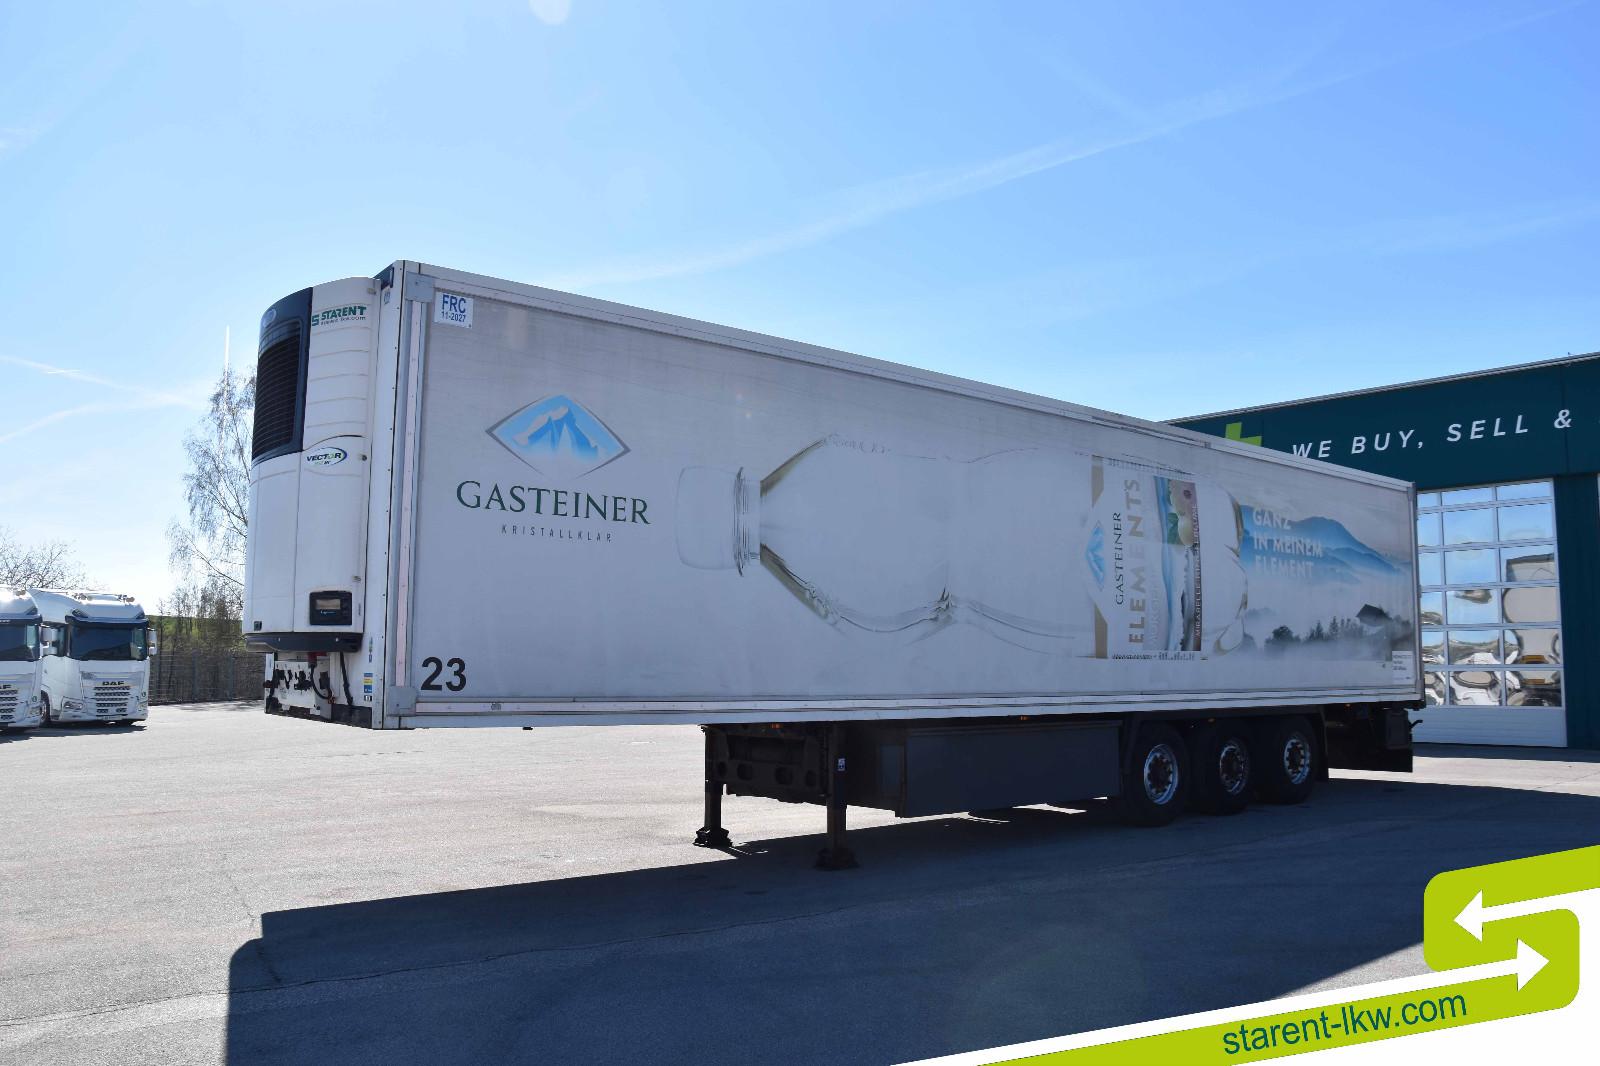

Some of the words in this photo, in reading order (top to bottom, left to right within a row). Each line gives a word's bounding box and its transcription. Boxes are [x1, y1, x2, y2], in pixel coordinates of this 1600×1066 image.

[321, 305, 367, 321] STARENT
[442, 294, 466, 313] FRC
[441, 311, 466, 322] 11-2027
[1293, 440, 1332, 459] WE
[1351, 429, 1425, 455] BUY,
[1446, 413, 1529, 442] SELL
[1553, 409, 1572, 428] &
[306, 452, 342, 462] VECTOR
[456, 480, 651, 525] GASTEINER
[1253, 508, 1292, 530] GANZ
[501, 524, 612, 543] KRISTALLKLAR
[1254, 532, 1268, 550] IN
[1274, 536, 1323, 558] MEINEM
[1112, 512, 1124, 605] GASTEINER
[1255, 554, 1314, 578] ELEMENT
[420, 656, 467, 692] 23
